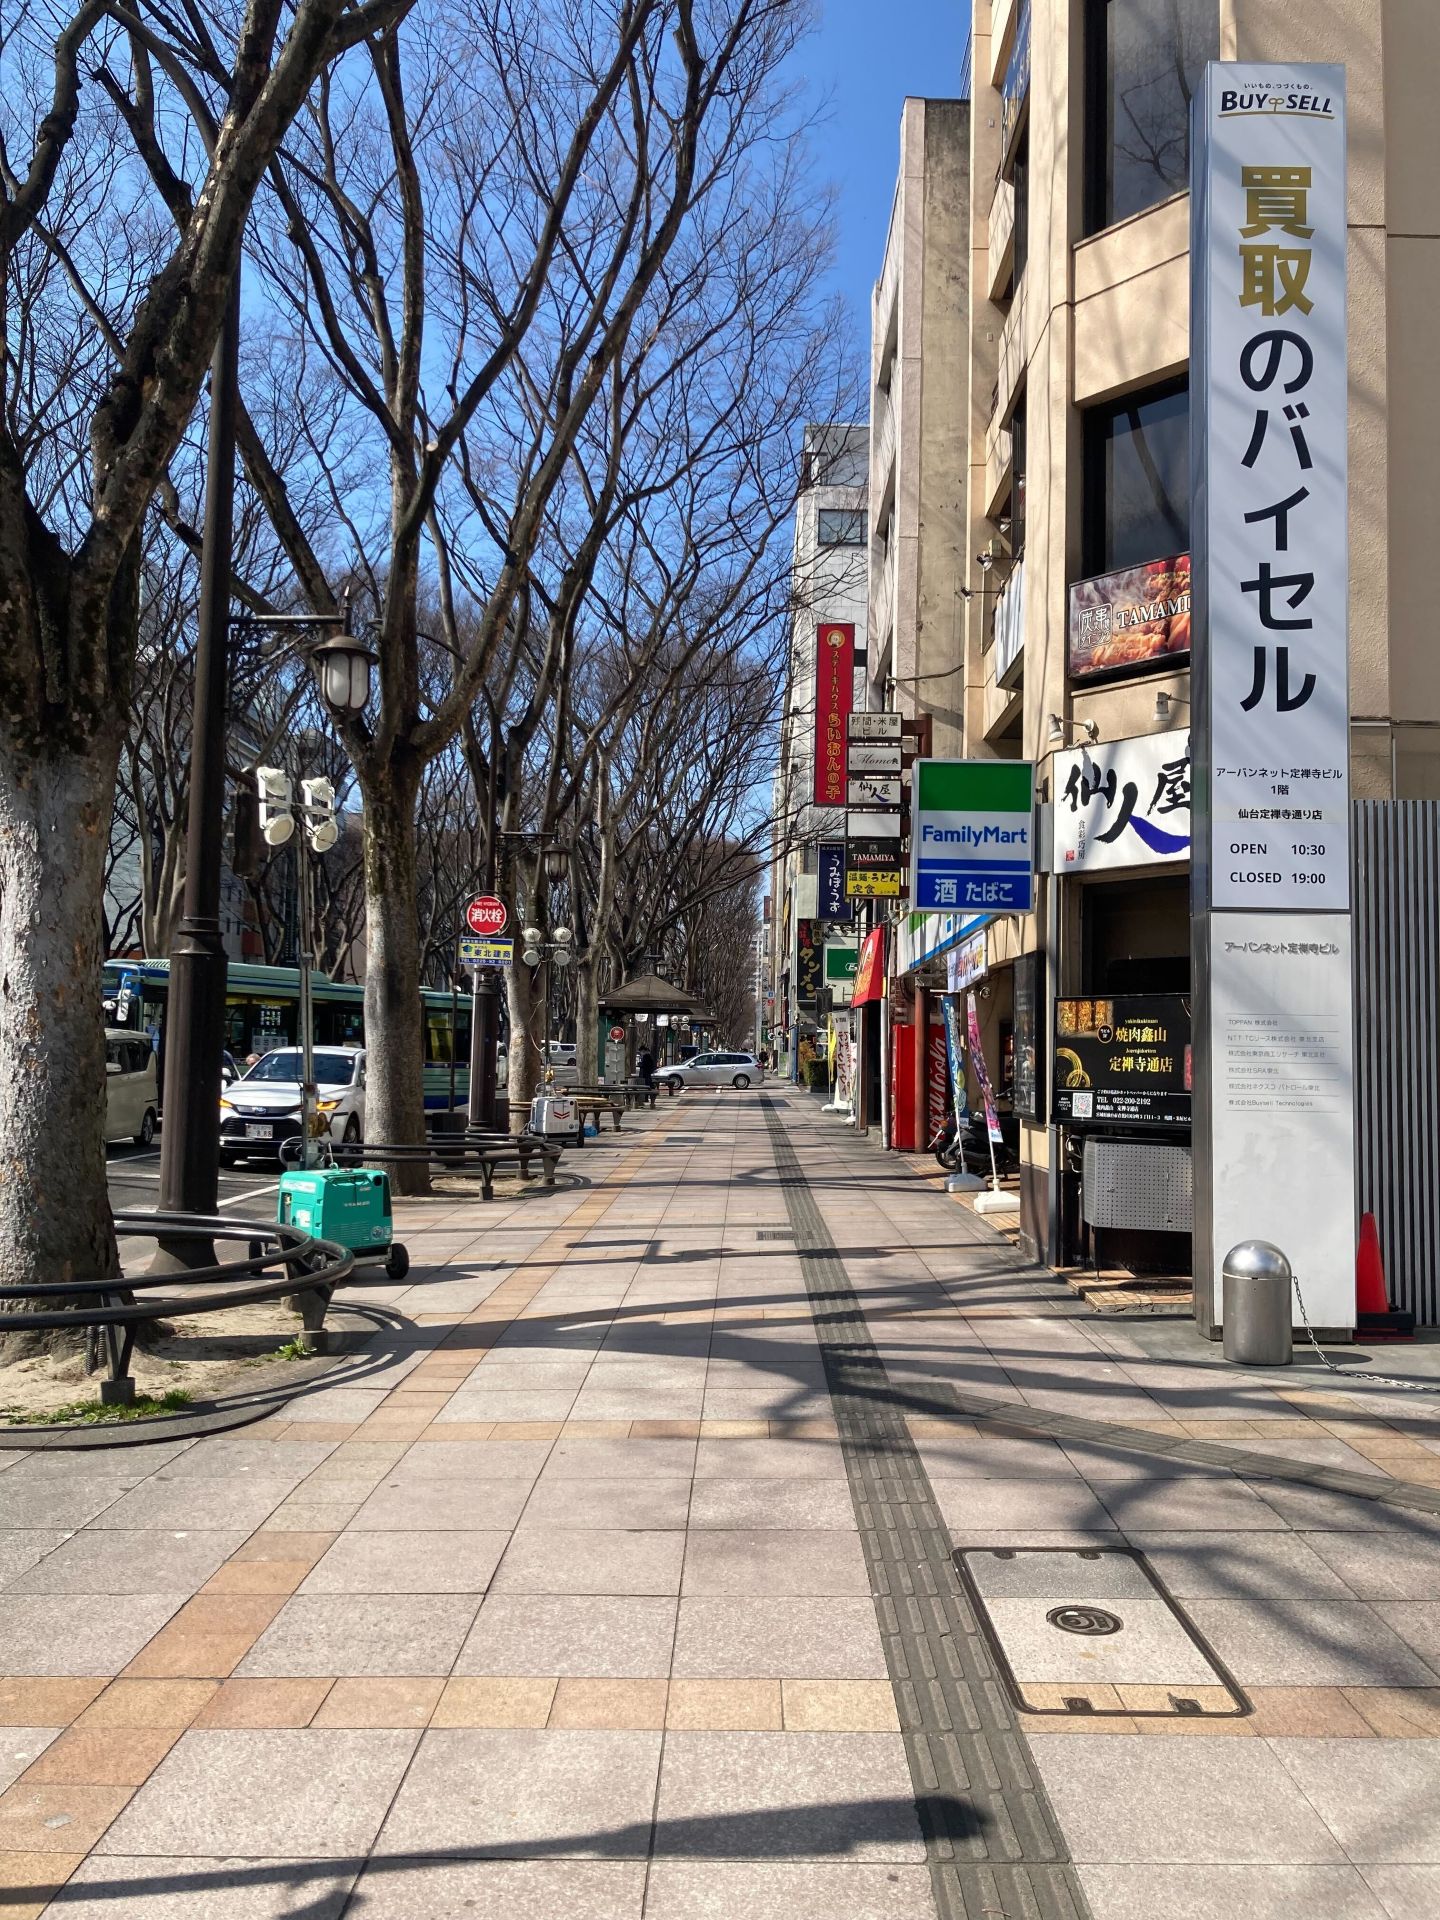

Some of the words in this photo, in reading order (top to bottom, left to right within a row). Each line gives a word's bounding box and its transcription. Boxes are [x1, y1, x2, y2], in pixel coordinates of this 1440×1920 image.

[1221, 91, 1268, 111] BUY
[1286, 94, 1332, 113] SELL
[1238, 166, 1316, 712] 買取のバイセル
[826, 712, 842, 800] らいおんの子
[1216, 768, 1343, 779] アーバンネット定禅寺ビル
[859, 781, 892, 803] 仙人屋
[1271, 785, 1289, 795] 1階
[1061, 757, 1190, 854] 仙人屋
[1238, 809, 1323, 820] 仙台定禅寺通り店
[923, 825, 1028, 847] FamilyMart
[1230, 843, 1267, 855] OPEN
[1291, 844, 1326, 856] 10:30
[852, 854, 895, 862] TAMAMIYA
[1230, 872, 1282, 883] CLOSED
[1291, 873, 1326, 884] 19:00
[853, 884, 875, 894] 定食
[934, 878, 957, 904] 酒
[966, 881, 1013, 902] たばこ
[471, 908, 503, 923] 消火栓
[1225, 942, 1339, 955] アーバンネット定禅寺ビル
[1109, 1057, 1173, 1073] 定禅寺通店
[1097, 1096, 1109, 1104] TEL
